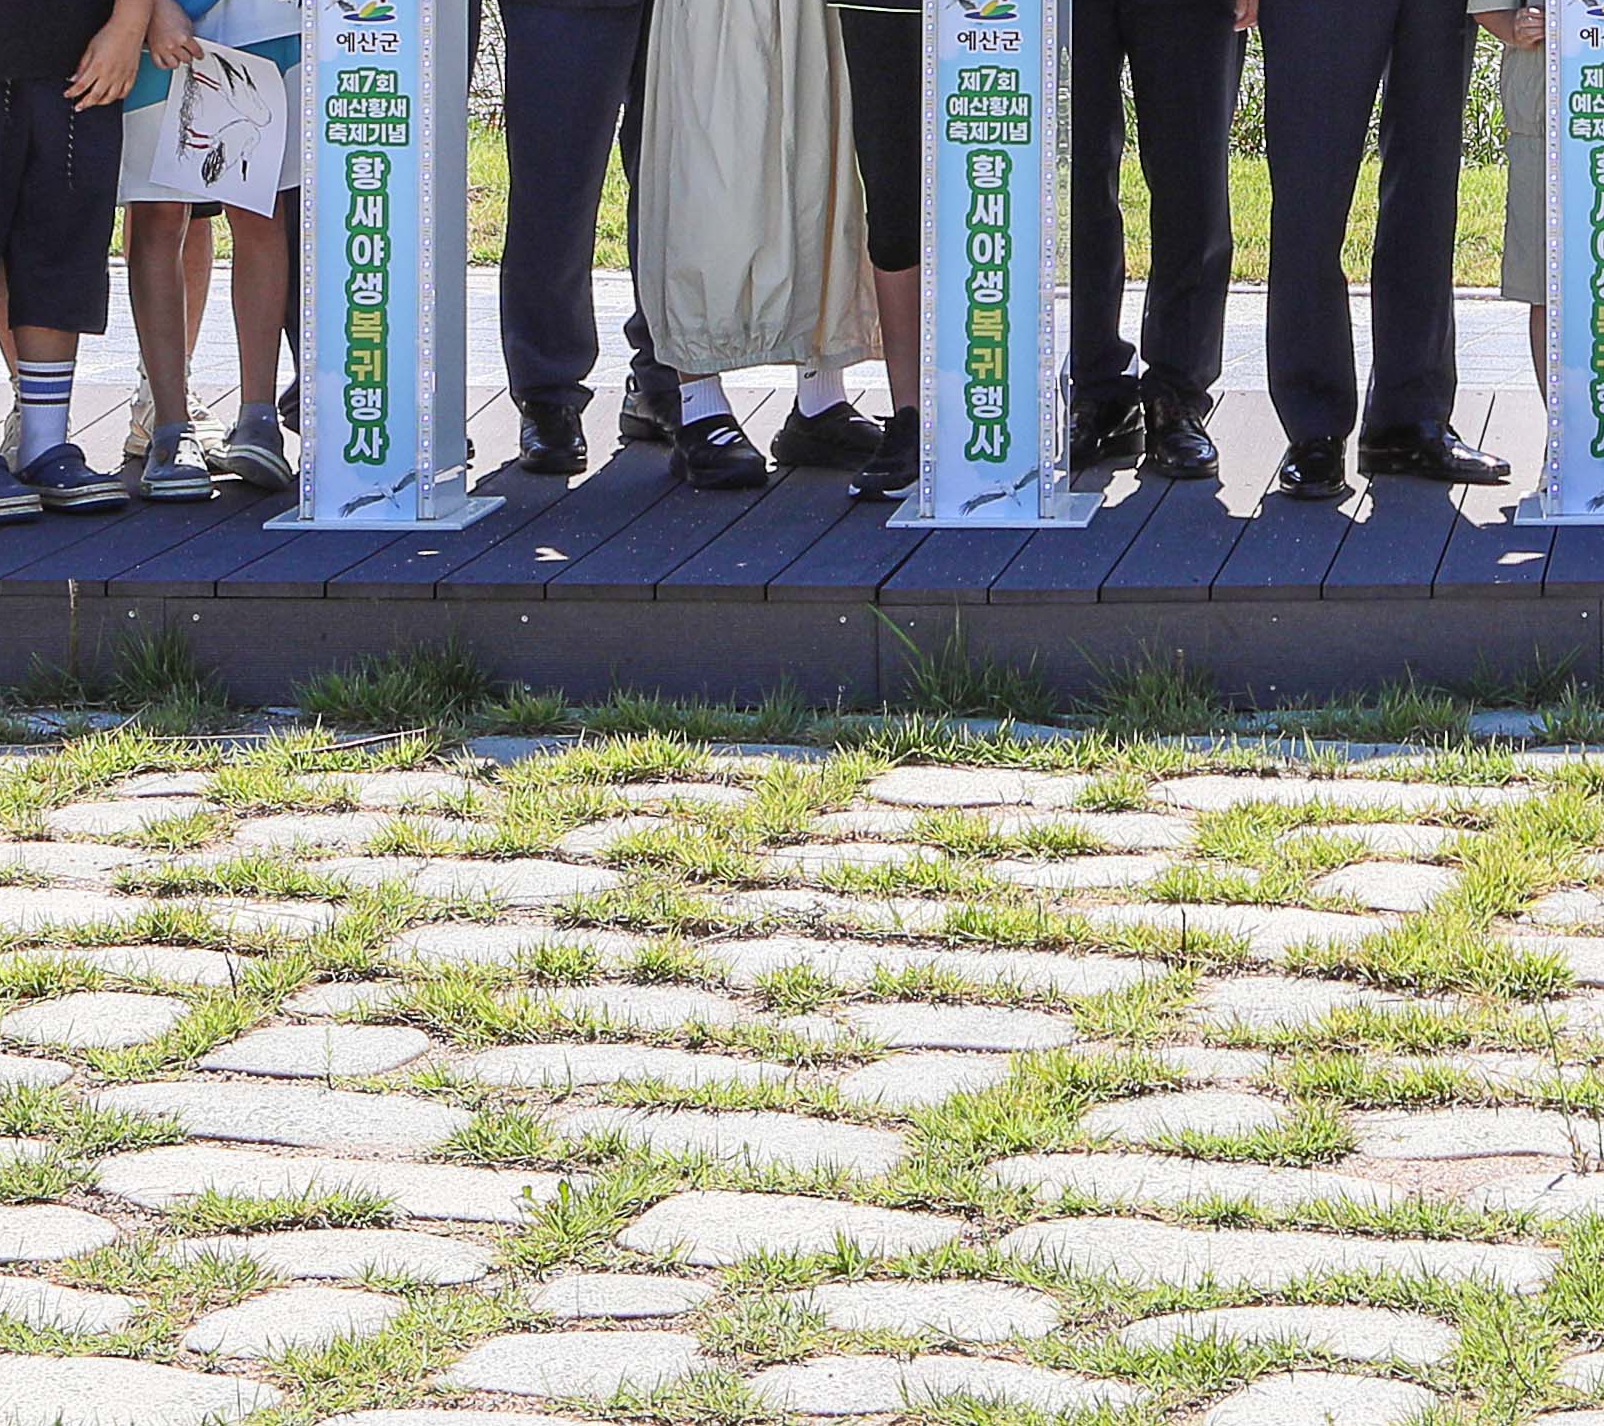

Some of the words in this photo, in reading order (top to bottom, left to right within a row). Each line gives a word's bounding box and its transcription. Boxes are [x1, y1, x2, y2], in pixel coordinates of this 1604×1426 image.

[335, 31, 399, 54] 예산군
[956, 29, 1021, 52] 예산군
[339, 69, 395, 95] 제7회
[960, 67, 1016, 93] 제7회
[328, 96, 408, 120] 예산황새
[949, 95, 1029, 119] 예산황새
[328, 122, 407, 145] 축제기념
[948, 121, 1029, 143] 축제기념
